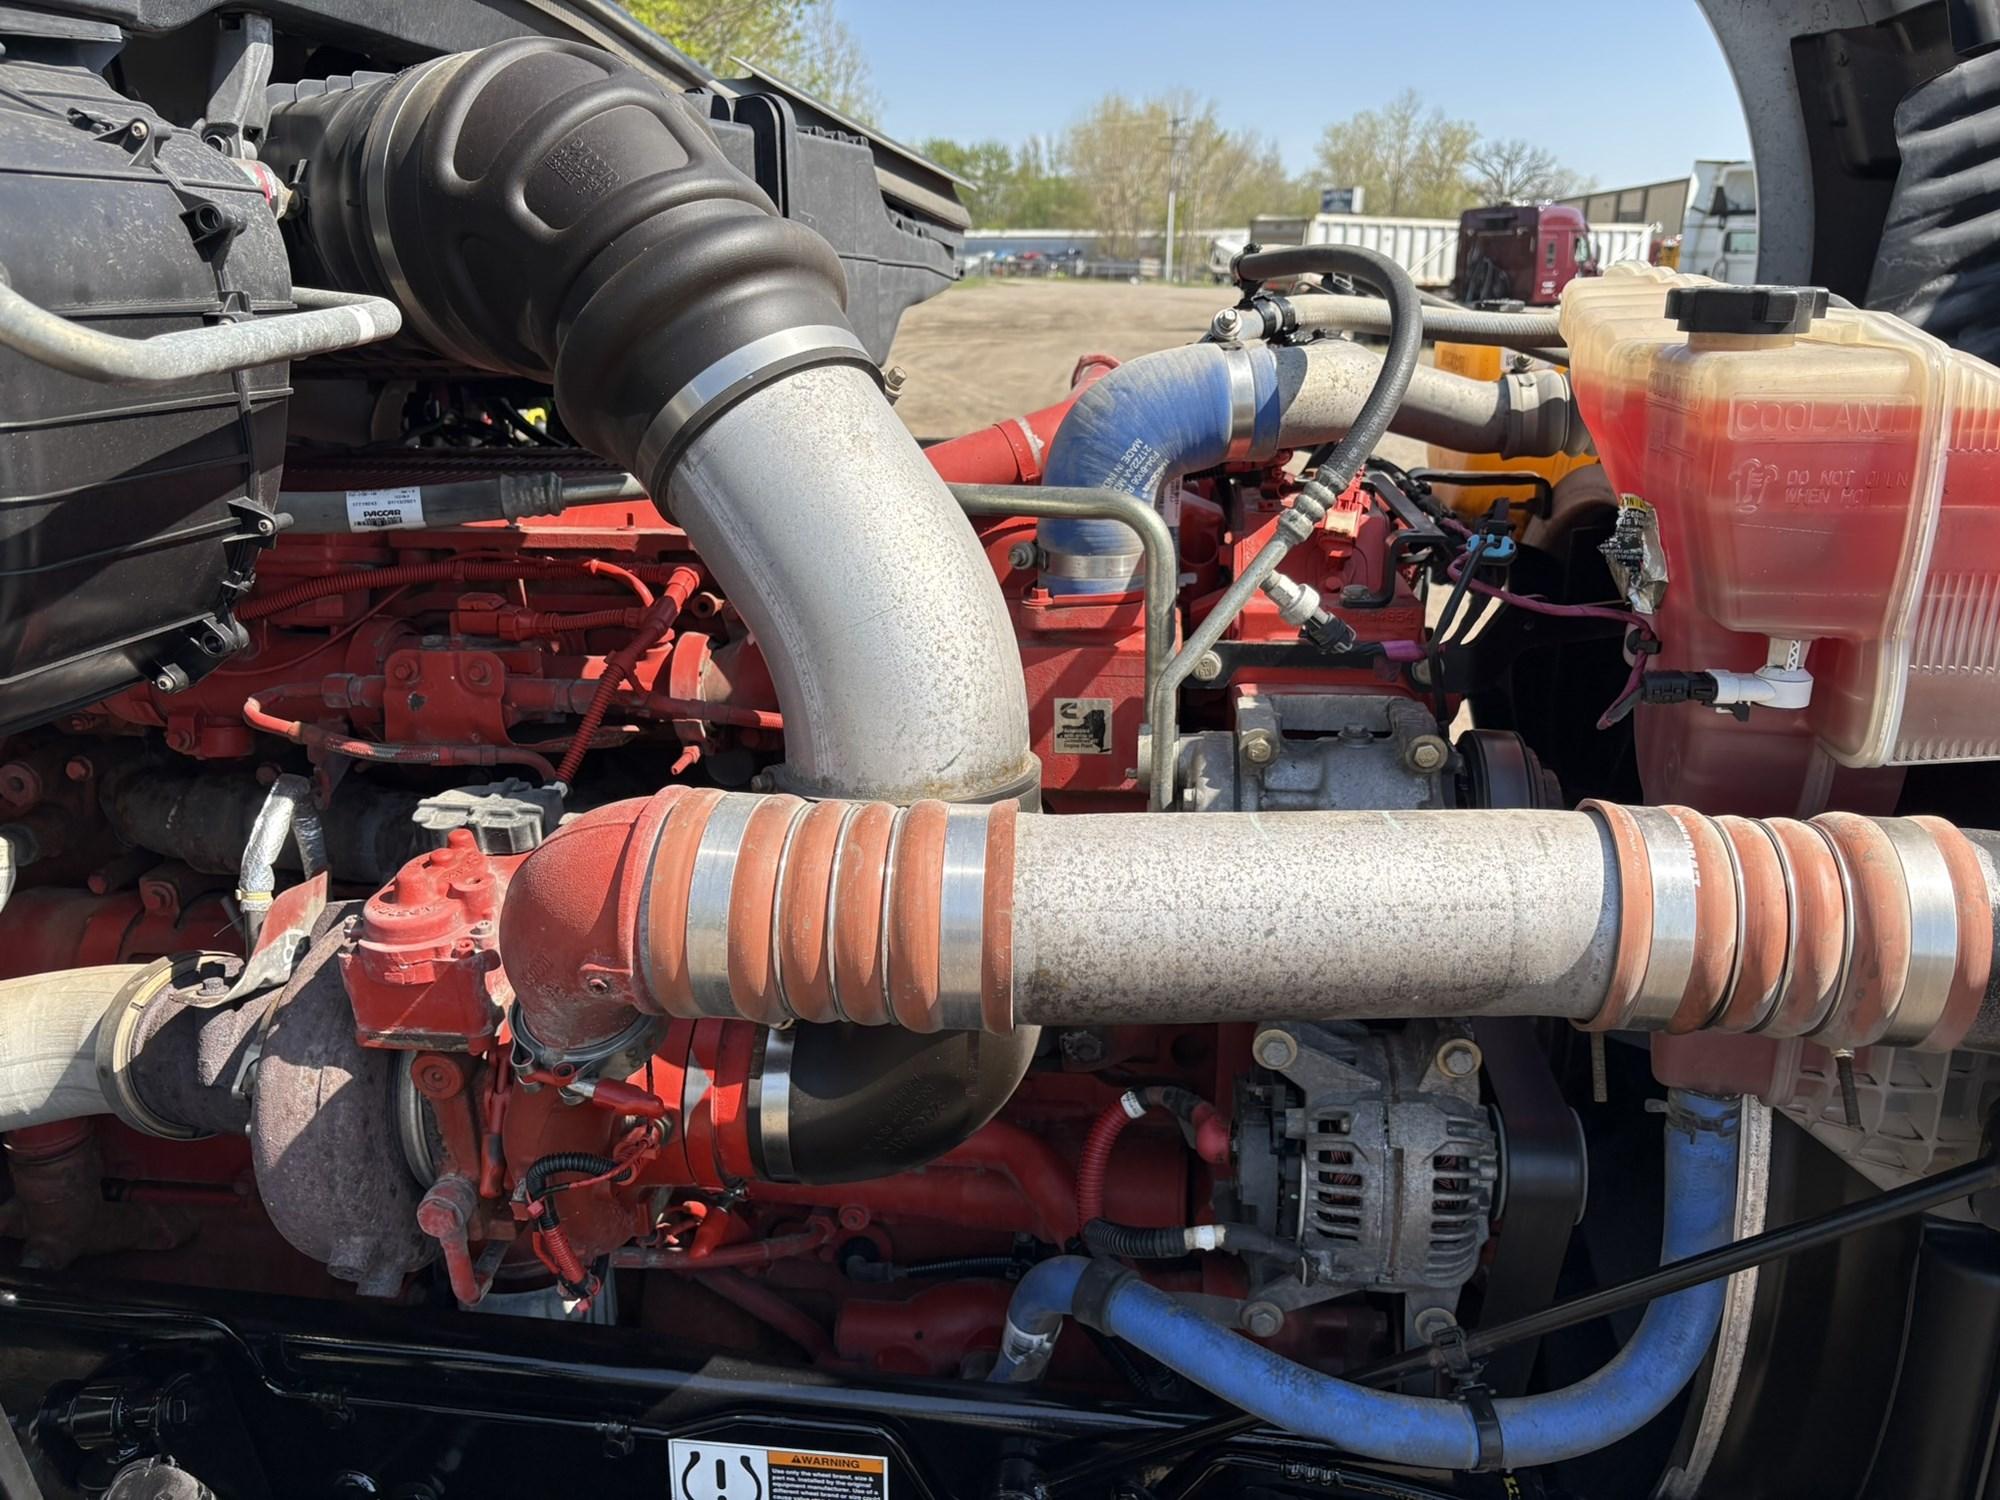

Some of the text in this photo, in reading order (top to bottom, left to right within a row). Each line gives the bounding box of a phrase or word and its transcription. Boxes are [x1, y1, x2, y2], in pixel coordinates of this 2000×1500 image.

[1120, 438, 1143, 464] MADE
[1113, 462, 1124, 473] IN
[1787, 471, 1809, 485] DO
[1821, 470, 1854, 486] NOT
[1785, 488, 1830, 503] WHEN
[363, 509, 401, 517] PACCAR
[802, 1456, 860, 1468] WARNING
